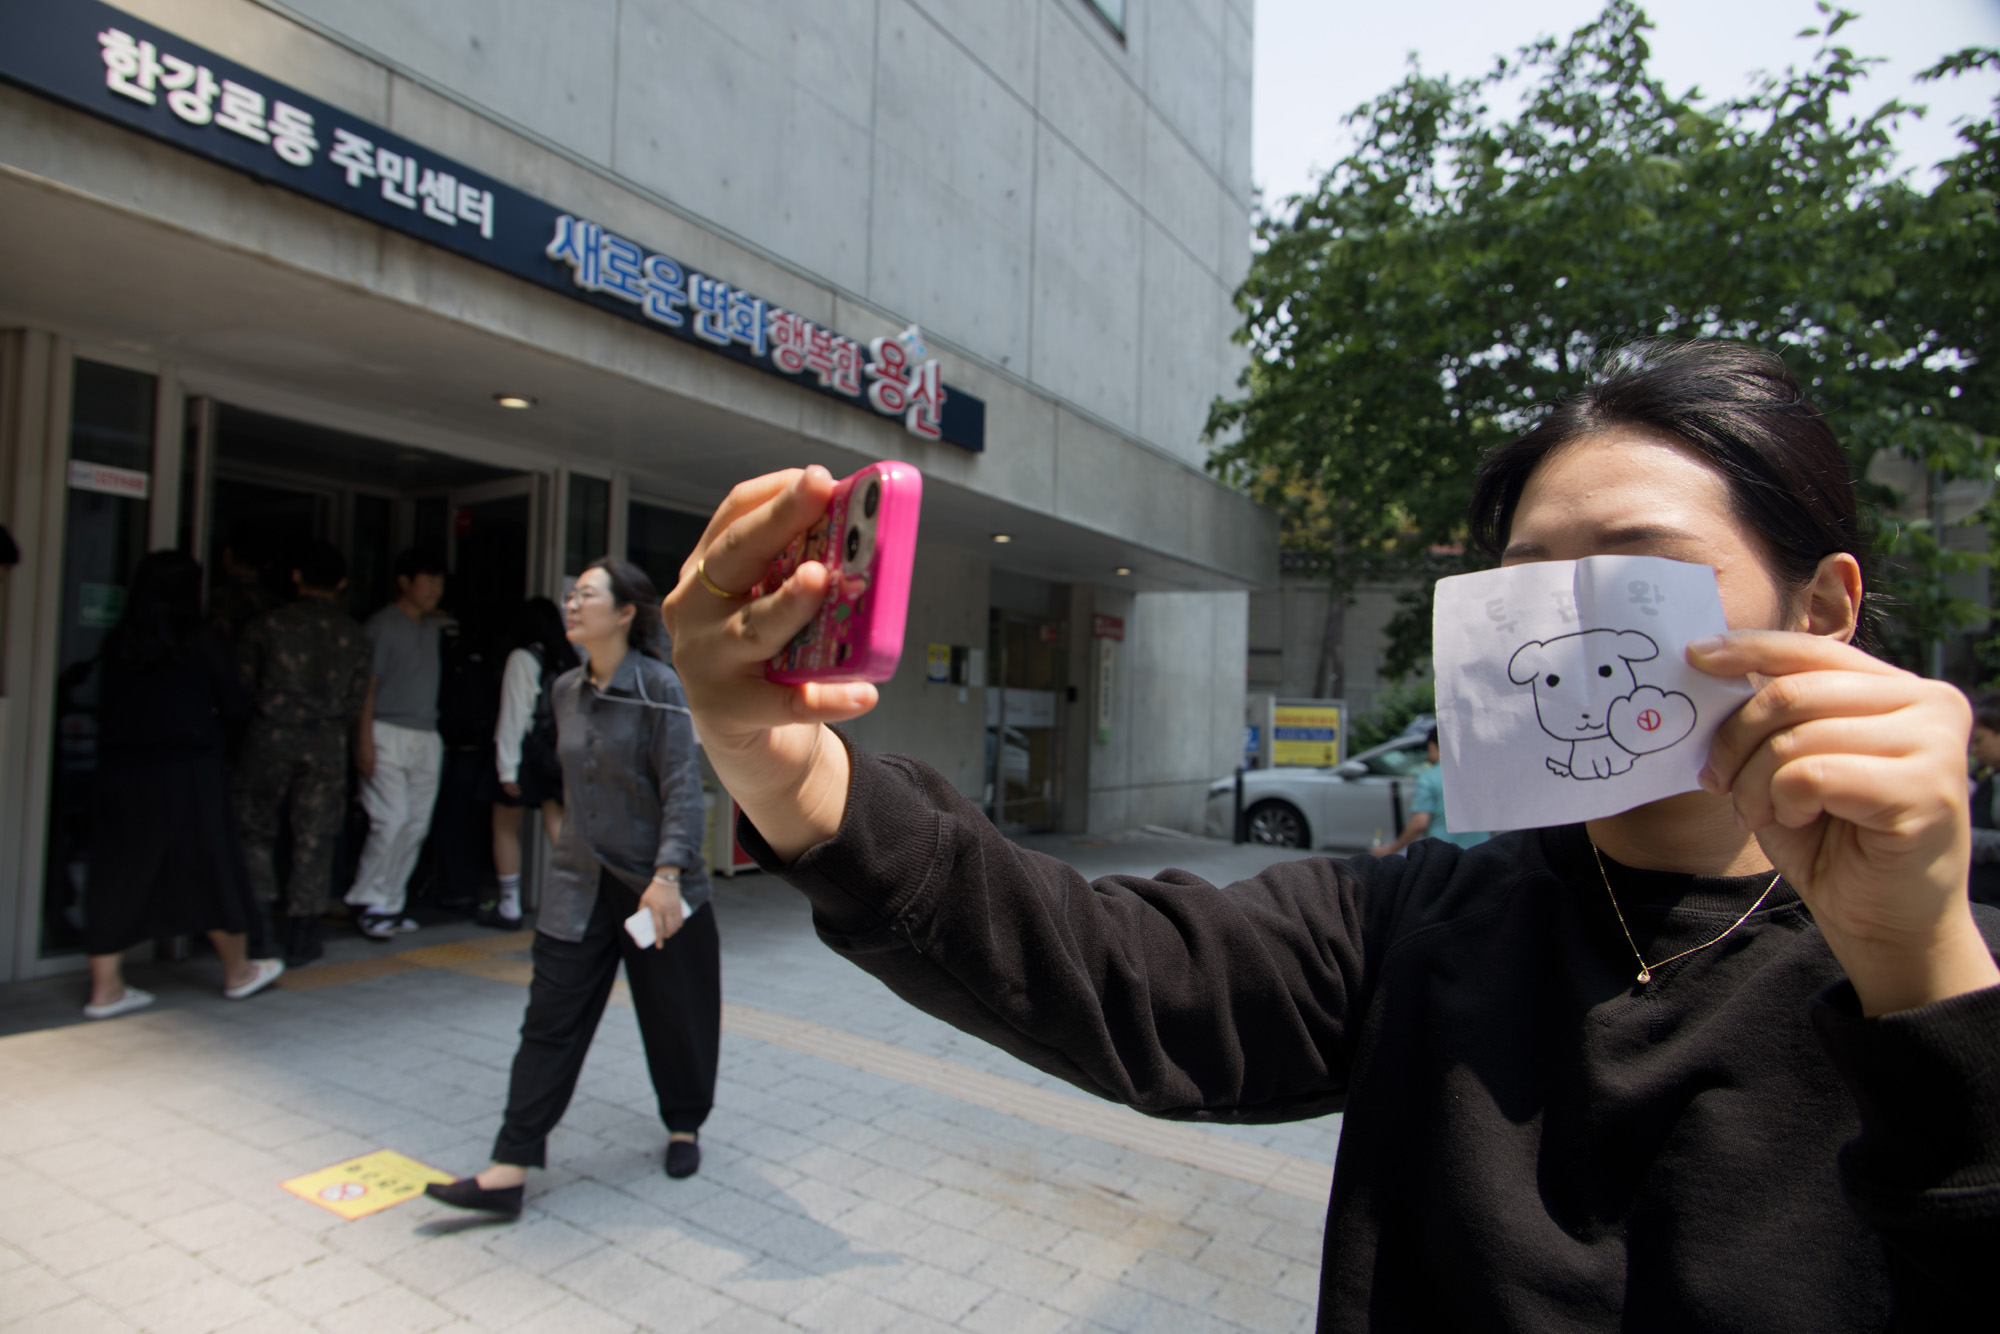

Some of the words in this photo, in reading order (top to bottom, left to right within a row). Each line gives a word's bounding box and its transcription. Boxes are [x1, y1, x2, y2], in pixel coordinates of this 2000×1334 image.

[98, 27, 320, 167] 한강로동
[330, 127, 495, 240] 주민센터
[546, 215, 688, 328] 새로운
[688, 273, 768, 357] 변화
[766, 307, 864, 397] 행복한
[864, 336, 947, 441] 용산
